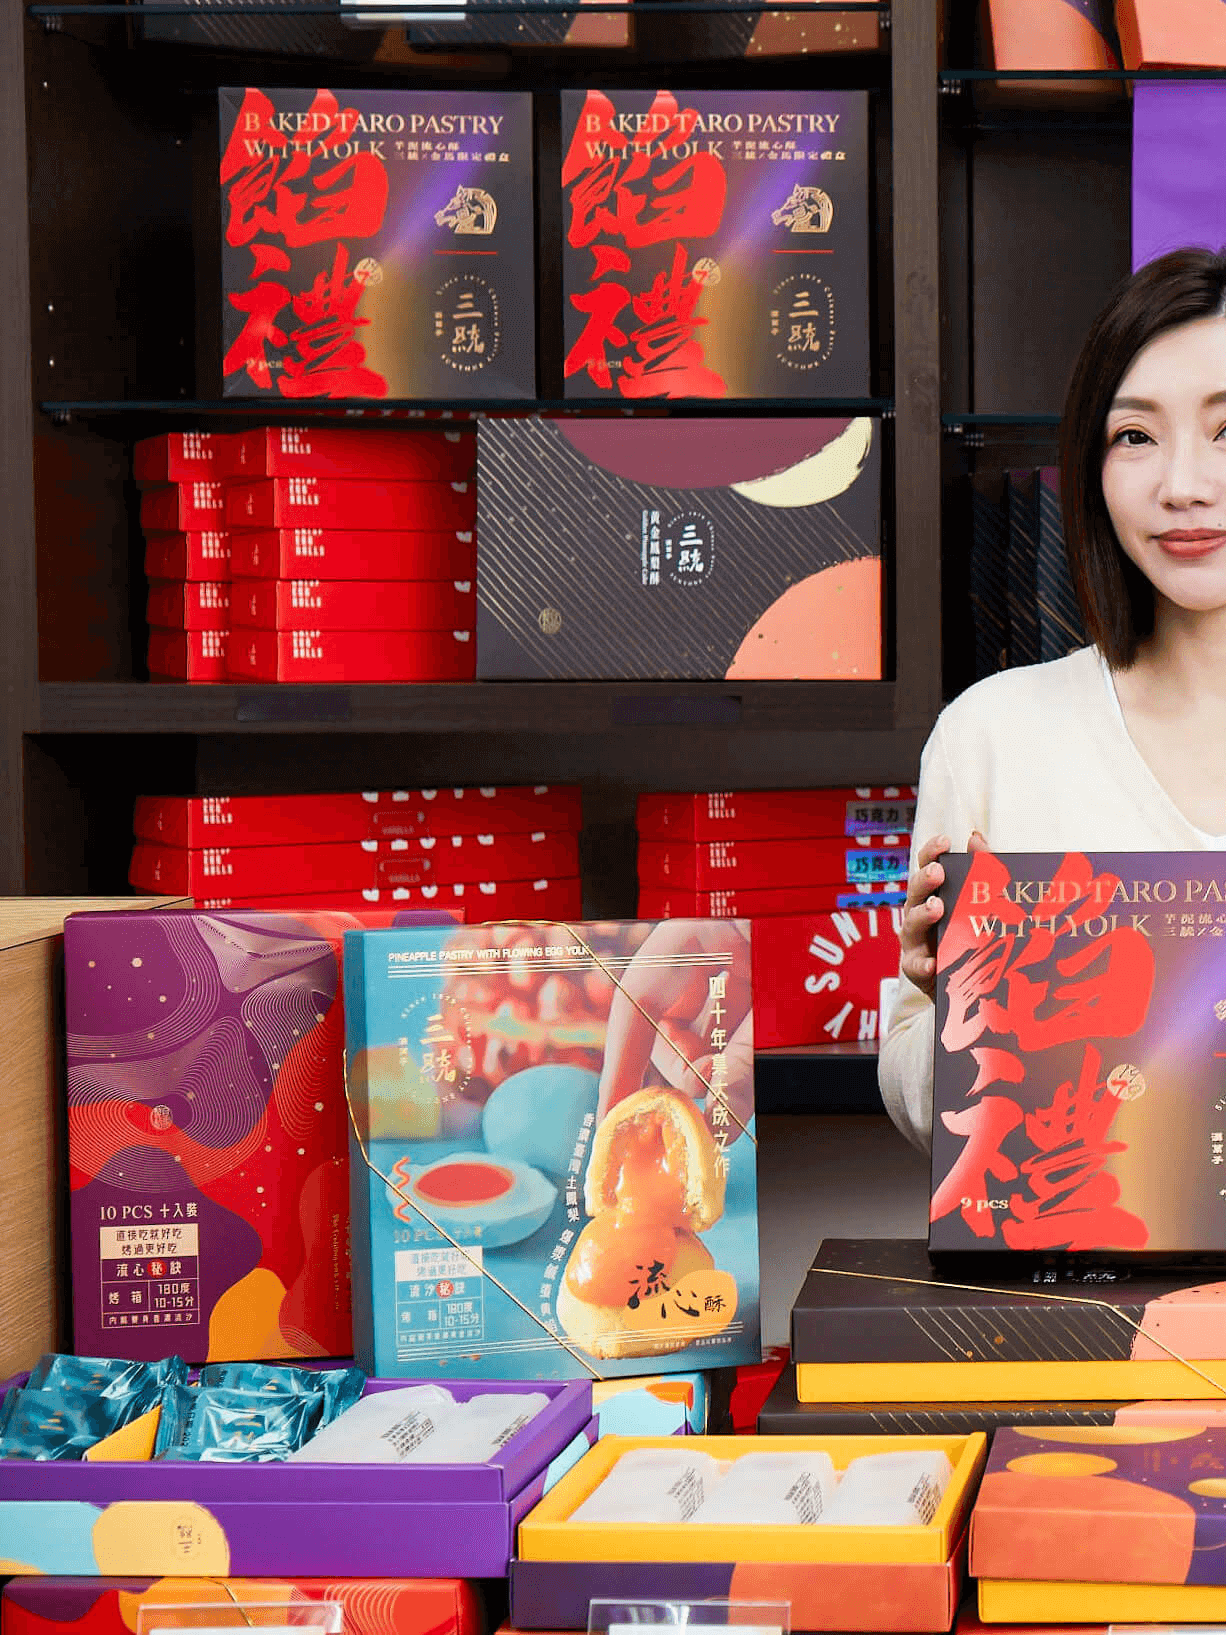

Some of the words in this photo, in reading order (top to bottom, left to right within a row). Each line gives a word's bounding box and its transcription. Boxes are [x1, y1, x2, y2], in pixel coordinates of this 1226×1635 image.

[244, 113, 331, 132] BAKED
[338, 113, 405, 133] TARO
[411, 115, 503, 134] PASTRY
[585, 113, 670, 132] BAKED
[675, 113, 743, 133] TARO
[748, 114, 840, 133] PASTRY
[244, 140, 315, 159] WITH
[585, 141, 653, 159] WITH
[452, 293, 484, 354] 三統
[788, 291, 820, 352] 三統
[678, 524, 703, 572] 三統
[971, 880, 1079, 904] BAKED
[1093, 880, 1177, 903] TARO
[969, 914, 1056, 937] WITH
[388, 952, 437, 962] PINEAPPLE
[439, 950, 474, 961] PASTRY
[476, 949, 500, 959] WITH
[502, 947, 543, 958] FLOWING
[545, 946, 564, 956] EGG
[420, 1013, 457, 1083] 三統
[101, 1206, 117, 1220] 10
[122, 1205, 153, 1219] PCS
[160, 1203, 199, 1218] 十入裝
[960, 1197, 973, 1209] 9
[976, 1198, 1009, 1214] pcs
[116, 1228, 183, 1241] 直接吃就好吃
[122, 1243, 177, 1256] 烤過更好吃
[116, 1261, 182, 1277] 流心秘訣
[157, 1283, 191, 1295] 180度
[154, 1297, 194, 1309] 10-15分
